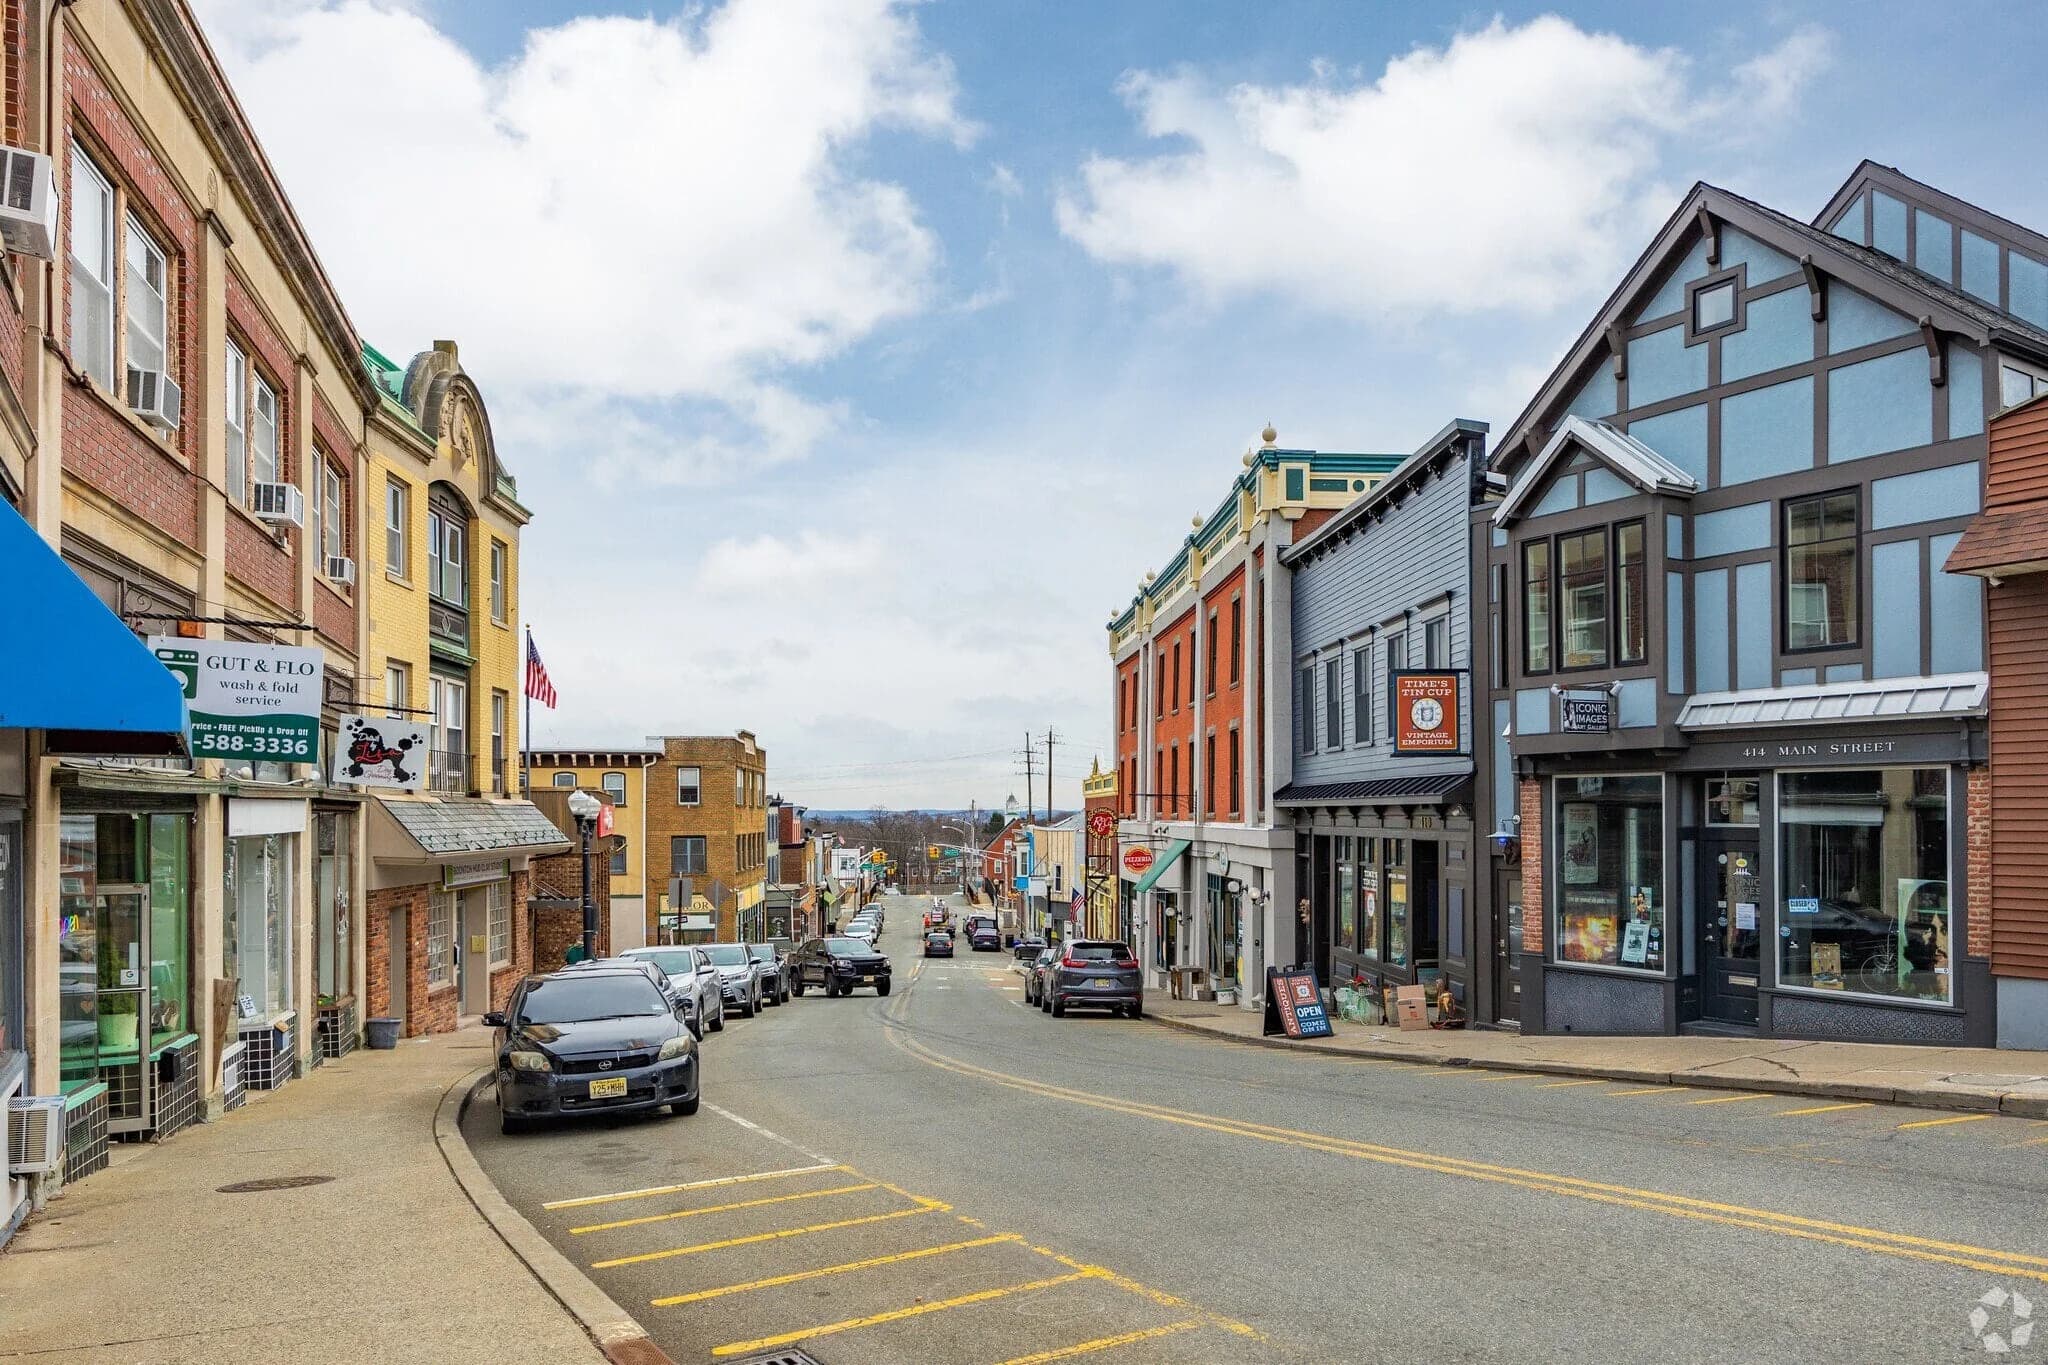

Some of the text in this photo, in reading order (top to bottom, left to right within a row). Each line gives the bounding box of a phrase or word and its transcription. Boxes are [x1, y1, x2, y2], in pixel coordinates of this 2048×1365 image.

[206, 655, 314, 676] GUT & FLO
[219, 680, 298, 694] wash & fold
[1404, 680, 1448, 688] TIME'S
[235, 695, 281, 707] service
[1575, 703, 1607, 713] ICONIC
[1576, 715, 1607, 724] IMAGES
[192, 723, 211, 731] rvice
[218, 724, 236, 732] FREE
[276, 727, 295, 736] Drop
[297, 729, 309, 737] Off
[193, 734, 309, 756] -588-3336
[1743, 742, 1895, 757] 414 MAIN STREET
[1297, 1005, 1322, 1017] OPEN
[1301, 1020, 1326, 1028] COME
